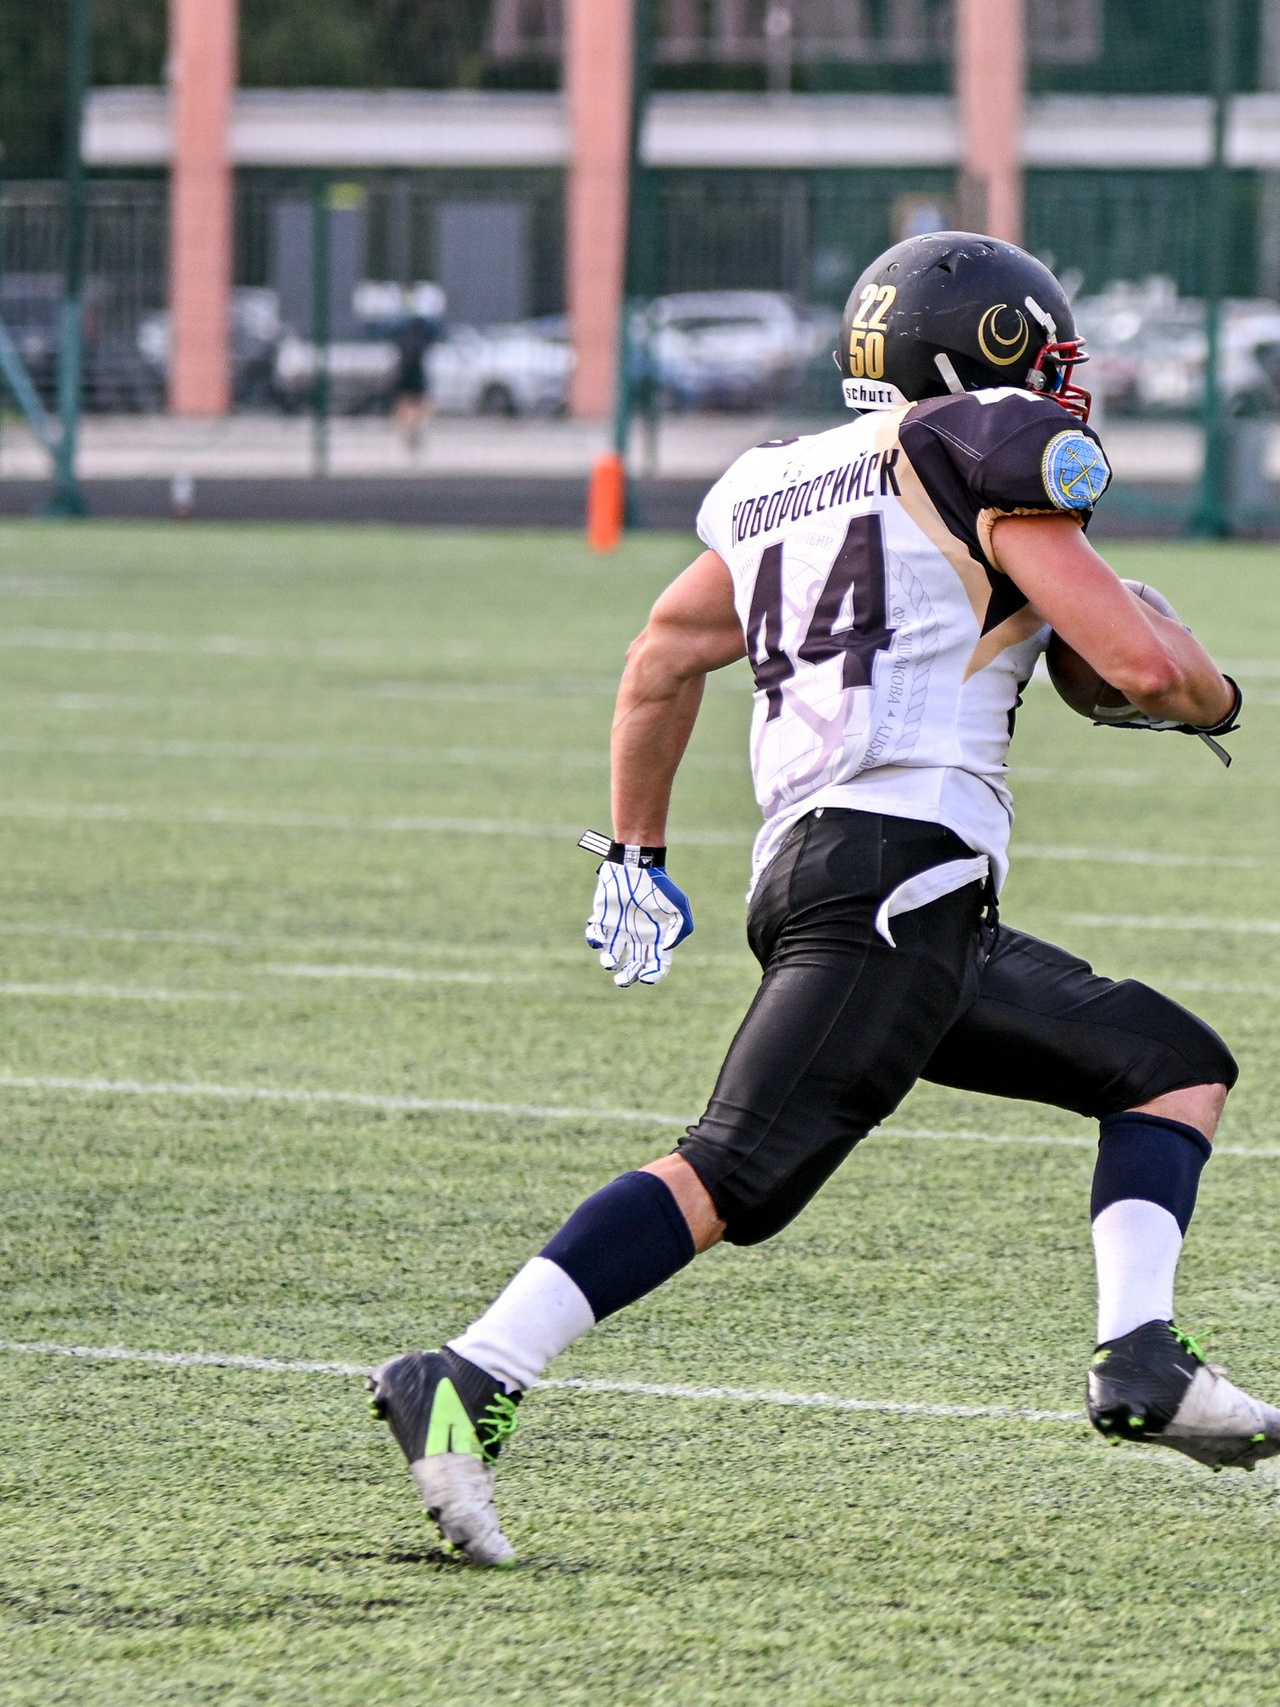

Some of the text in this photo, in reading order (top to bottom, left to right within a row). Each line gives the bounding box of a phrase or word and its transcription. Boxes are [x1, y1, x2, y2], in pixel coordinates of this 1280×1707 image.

[852, 283, 897, 330] 22
[849, 329, 885, 379] 50
[845, 385, 893, 403] schutt
[732, 449, 901, 548] НОВОРОССИЙСК
[747, 513, 898, 724] 44
[888, 631, 913, 705] УШАКОВА
